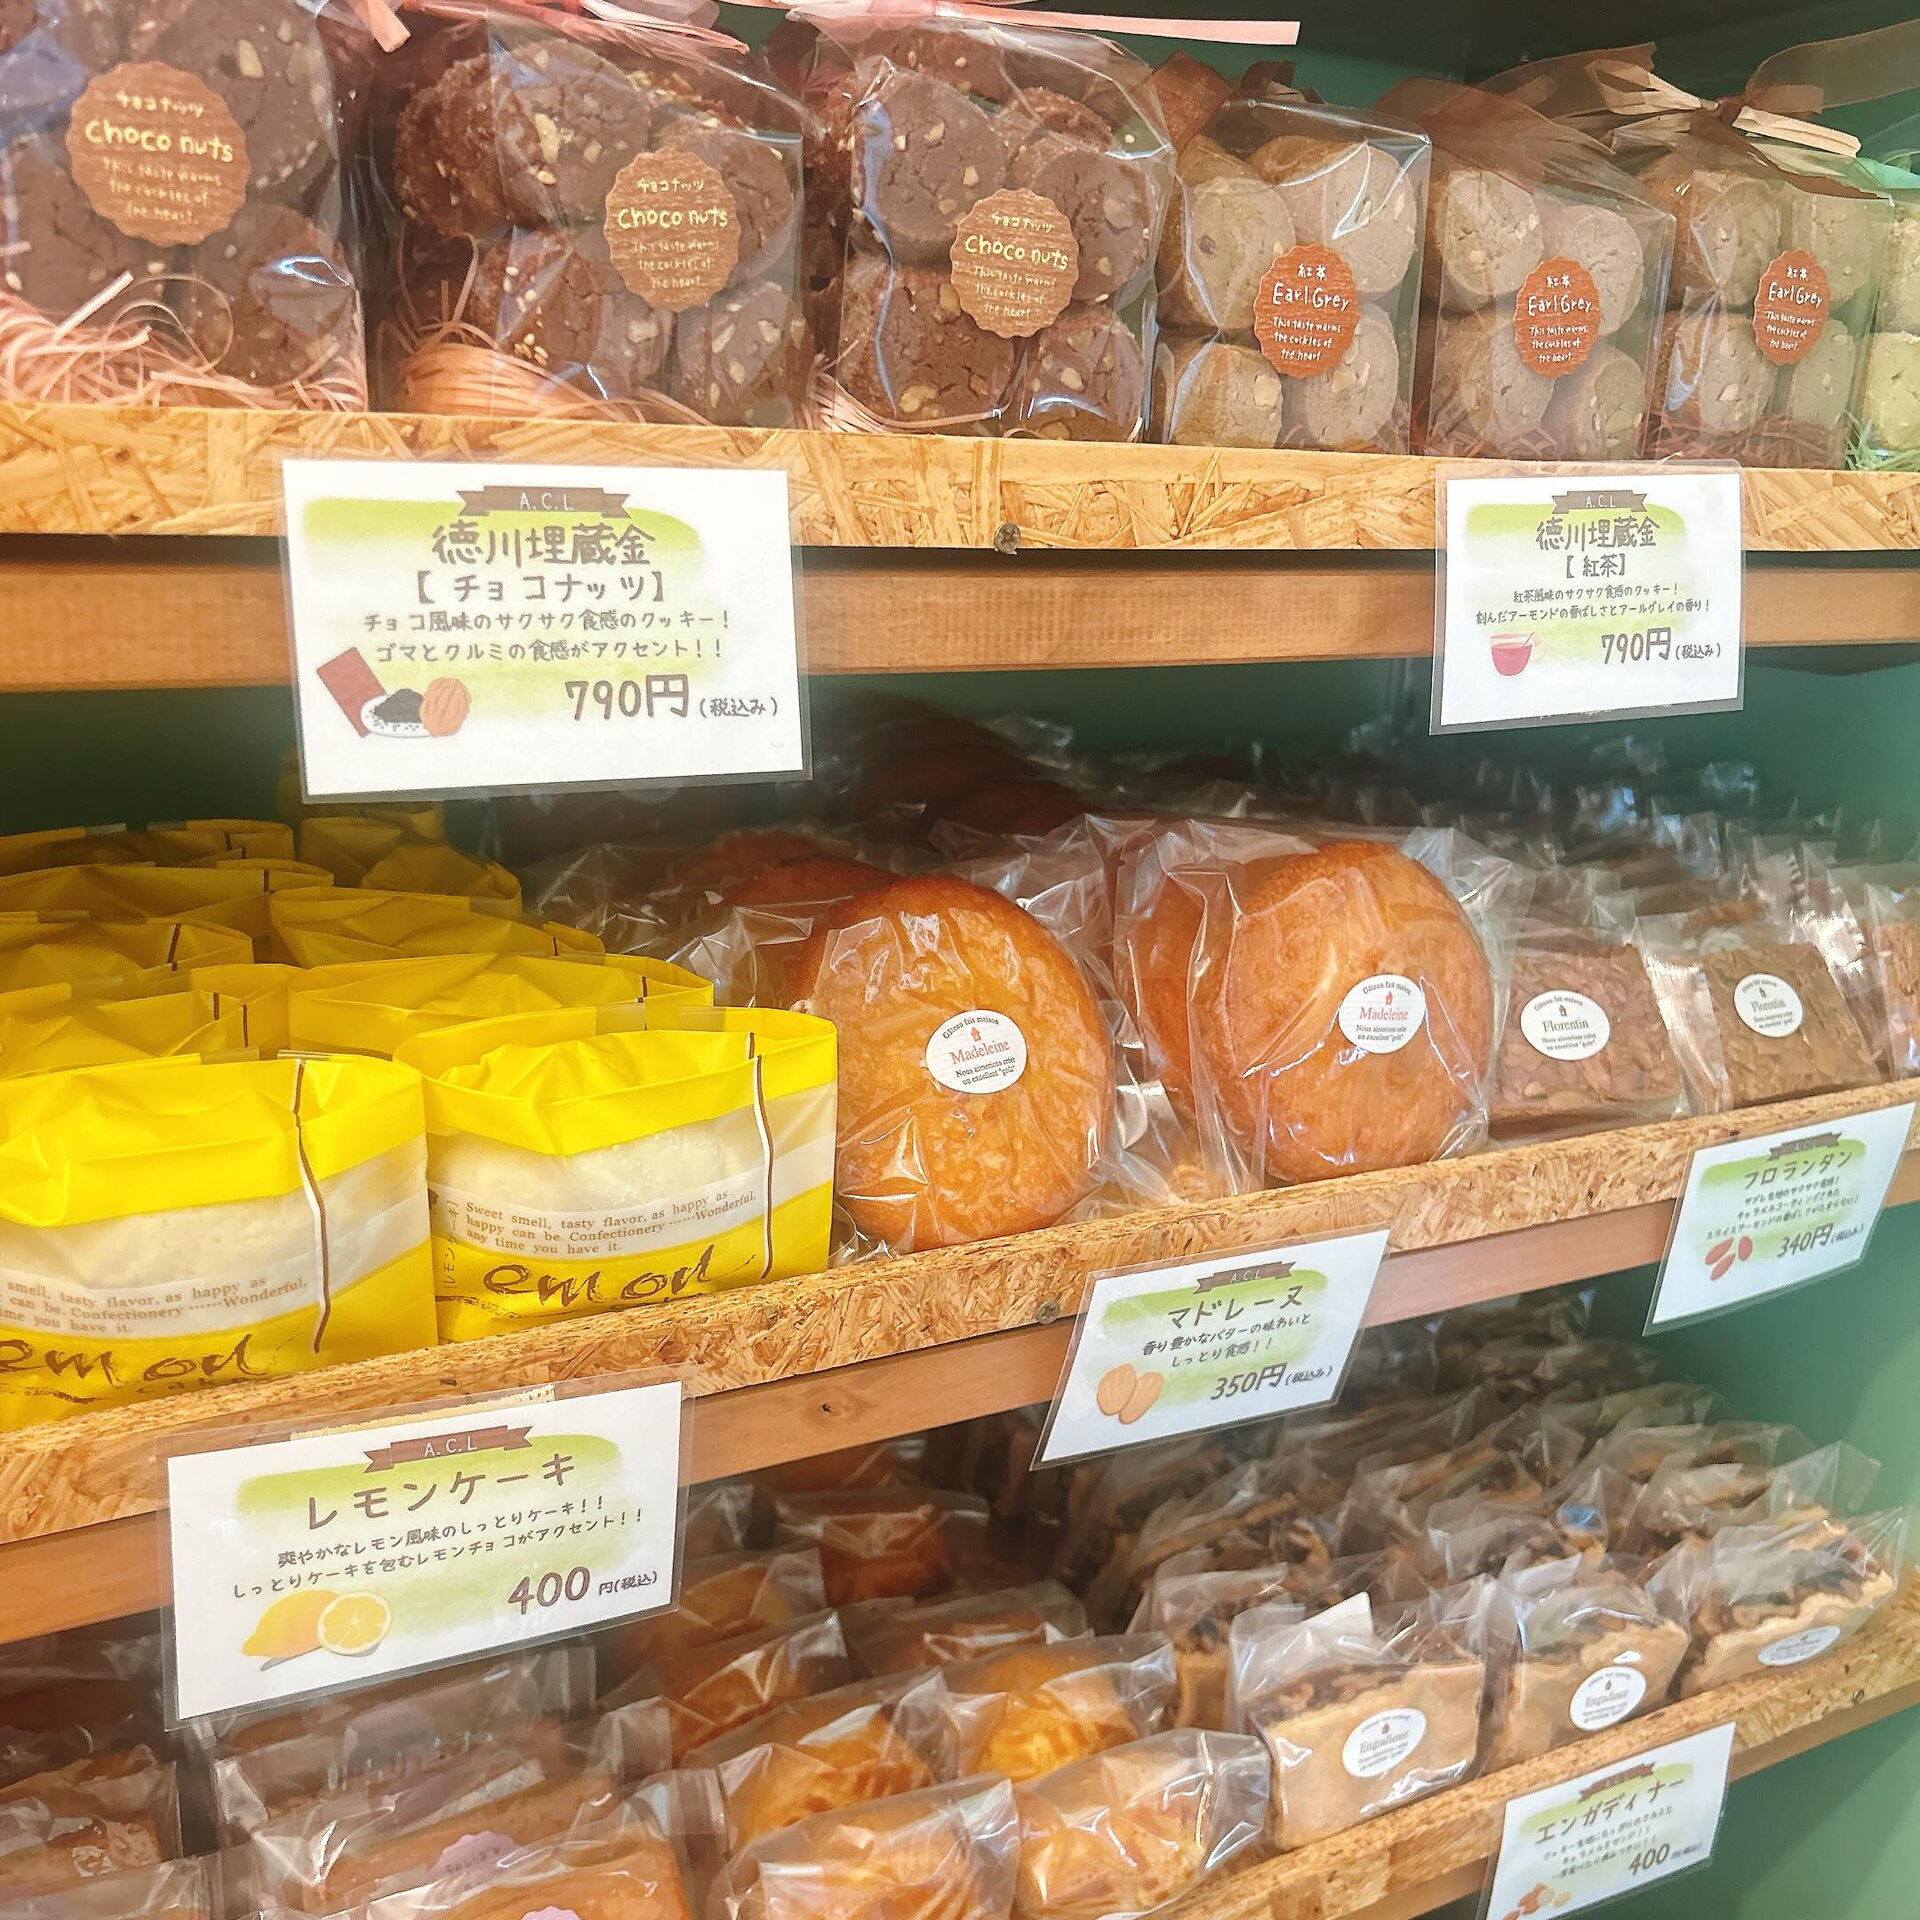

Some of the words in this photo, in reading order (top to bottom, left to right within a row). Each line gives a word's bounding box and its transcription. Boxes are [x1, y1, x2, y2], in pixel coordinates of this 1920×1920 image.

[85, 118, 171, 151] Choco
[180, 135, 233, 162] nuts
[618, 207, 682, 229] Choco
[689, 206, 728, 227] nuts
[965, 235, 1025, 260] Choco
[1031, 249, 1069, 270] nuts
[1273, 282, 1308, 304] Earl
[1313, 288, 1349, 311] Grey
[1528, 295, 1557, 316] Earl
[1561, 295, 1591, 313] Grey
[1769, 282, 1794, 301] Earl
[1796, 287, 1822, 308] Grey
[1274, 331, 1287, 343] the
[1323, 337, 1332, 348] of
[1281, 348, 1294, 359] the
[1532, 340, 1543, 349] the
[1572, 337, 1581, 349] of
[519, 492, 574, 512] A.C.L
[1585, 495, 1617, 508] A.C.L
[432, 519, 655, 568] 徳川埋蔵金
[1535, 516, 1660, 551] 徳川埋蔵金
[1566, 553, 1626, 579] 【紅茶】
[417, 570, 664, 605] 【チョコナッツ】
[1513, 583, 1678, 604] 紅茶風味のサクサク食感のクッキー！
[364, 609, 731, 633] チョコ風味のサクサク食感のクッキー！
[1476, 599, 1710, 626] 刻んだアーモンドの香ばしさとアールグレイの香り！
[376, 639, 722, 664] ゴマとクルミの食感がアクセント！！
[1601, 627, 1671, 665] 790円
[564, 673, 690, 721] 790円
[1360, 1006, 1409, 1021] Madeleine
[1542, 1017, 1589, 1032] Florentin
[949, 1040, 1010, 1065] Madeleine
[955, 1068, 973, 1078] Nous
[1744, 1152, 1853, 1190] フロランタン
[466, 1202, 504, 1220] Sweet
[511, 1214, 551, 1229] smell,
[561, 1219, 596, 1230] tasty
[651, 1209, 665, 1220] as
[673, 1196, 710, 1216] happy
[715, 1190, 729, 1201] as
[467, 1214, 505, 1235] happy
[512, 1229, 535, 1239] can
[569, 1221, 667, 1243] Confectionery
[467, 1229, 488, 1243] any
[495, 1238, 525, 1250] time
[533, 1244, 557, 1254] you
[567, 1244, 600, 1254] have
[1777, 1222, 1834, 1258] 340円
[61, 1291, 96, 1308] tasty
[166, 1292, 181, 1302] as
[192, 1283, 240, 1299] happy
[250, 1278, 267, 1288] as
[1168, 1285, 1304, 1330] マドレーヌ
[0, 1308, 25, 1322] ime
[34, 1315, 60, 1328] you
[70, 1320, 106, 1333] have
[9, 1297, 35, 1309] can
[71, 1304, 184, 1321] Confectionery
[1142, 1312, 1311, 1357] 香り豊かなバターの味わいと
[1171, 1337, 1273, 1368] しっとり食感！！
[1210, 1361, 1288, 1401] 350円
[423, 1436, 477, 1458] A.C.L
[308, 1452, 577, 1531] レモンケーキ
[277, 1496, 604, 1568] 爽やかなレモン風味のしっとりケーキ！！
[234, 1508, 643, 1599] しっとりケーキを包むレモンチョコがアクセント！！
[507, 1565, 591, 1616] 400
[1535, 1778, 1686, 1844] エンガディナー
[1628, 1843, 1671, 1876] 400
